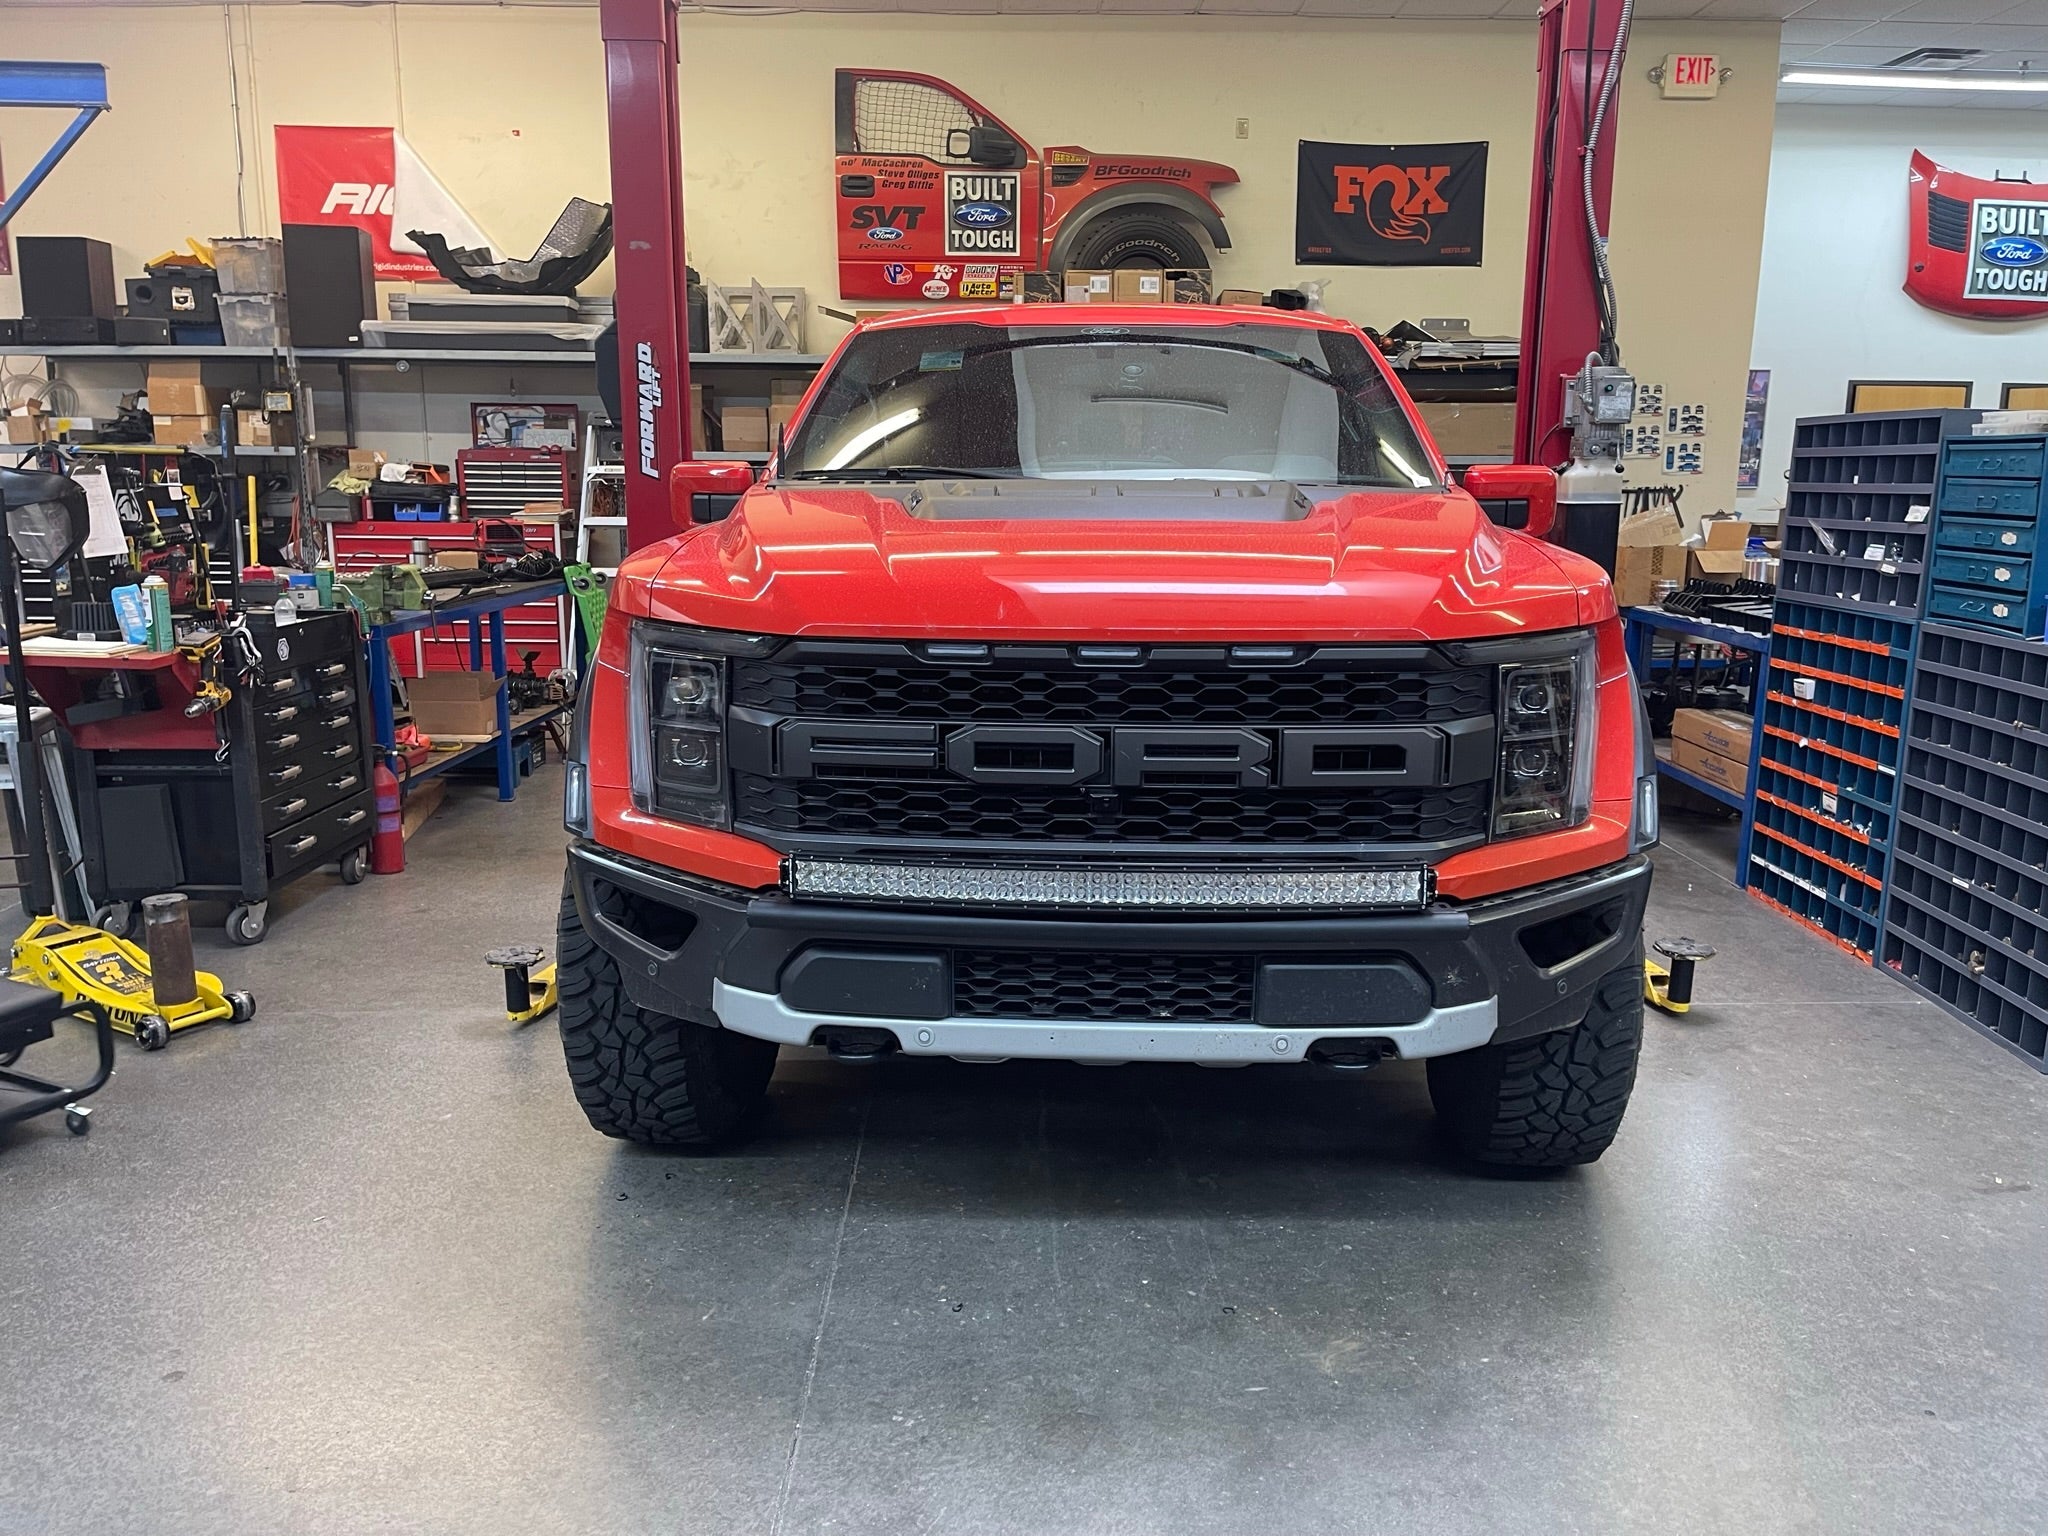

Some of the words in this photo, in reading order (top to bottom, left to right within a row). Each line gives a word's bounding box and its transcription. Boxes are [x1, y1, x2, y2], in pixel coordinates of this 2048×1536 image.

[1676, 57, 1713, 85] EXIT
[877, 168, 905, 178] Steve
[907, 169, 940, 179] Olliges
[1094, 165, 1192, 178] BFGoodrich
[882, 179, 906, 189] Greg
[908, 180, 934, 189] Biffle
[951, 177, 1015, 201] BUILT
[1333, 164, 1450, 216] FOX
[850, 205, 926, 230] SVT
[858, 243, 913, 251] RACING
[951, 229, 1014, 249] TOUGH
[1100, 239, 1180, 266] BFGoodrich
[884, 263, 905, 283] VP
[1975, 268, 2048, 292] TOUGH
[966, 289, 996, 297] Meter
[651, 367, 663, 408] LIFT
[637, 342, 660, 480] FORWARD
[777, 720, 1445, 788] FORD
[83, 954, 121, 969] DAYTONA
